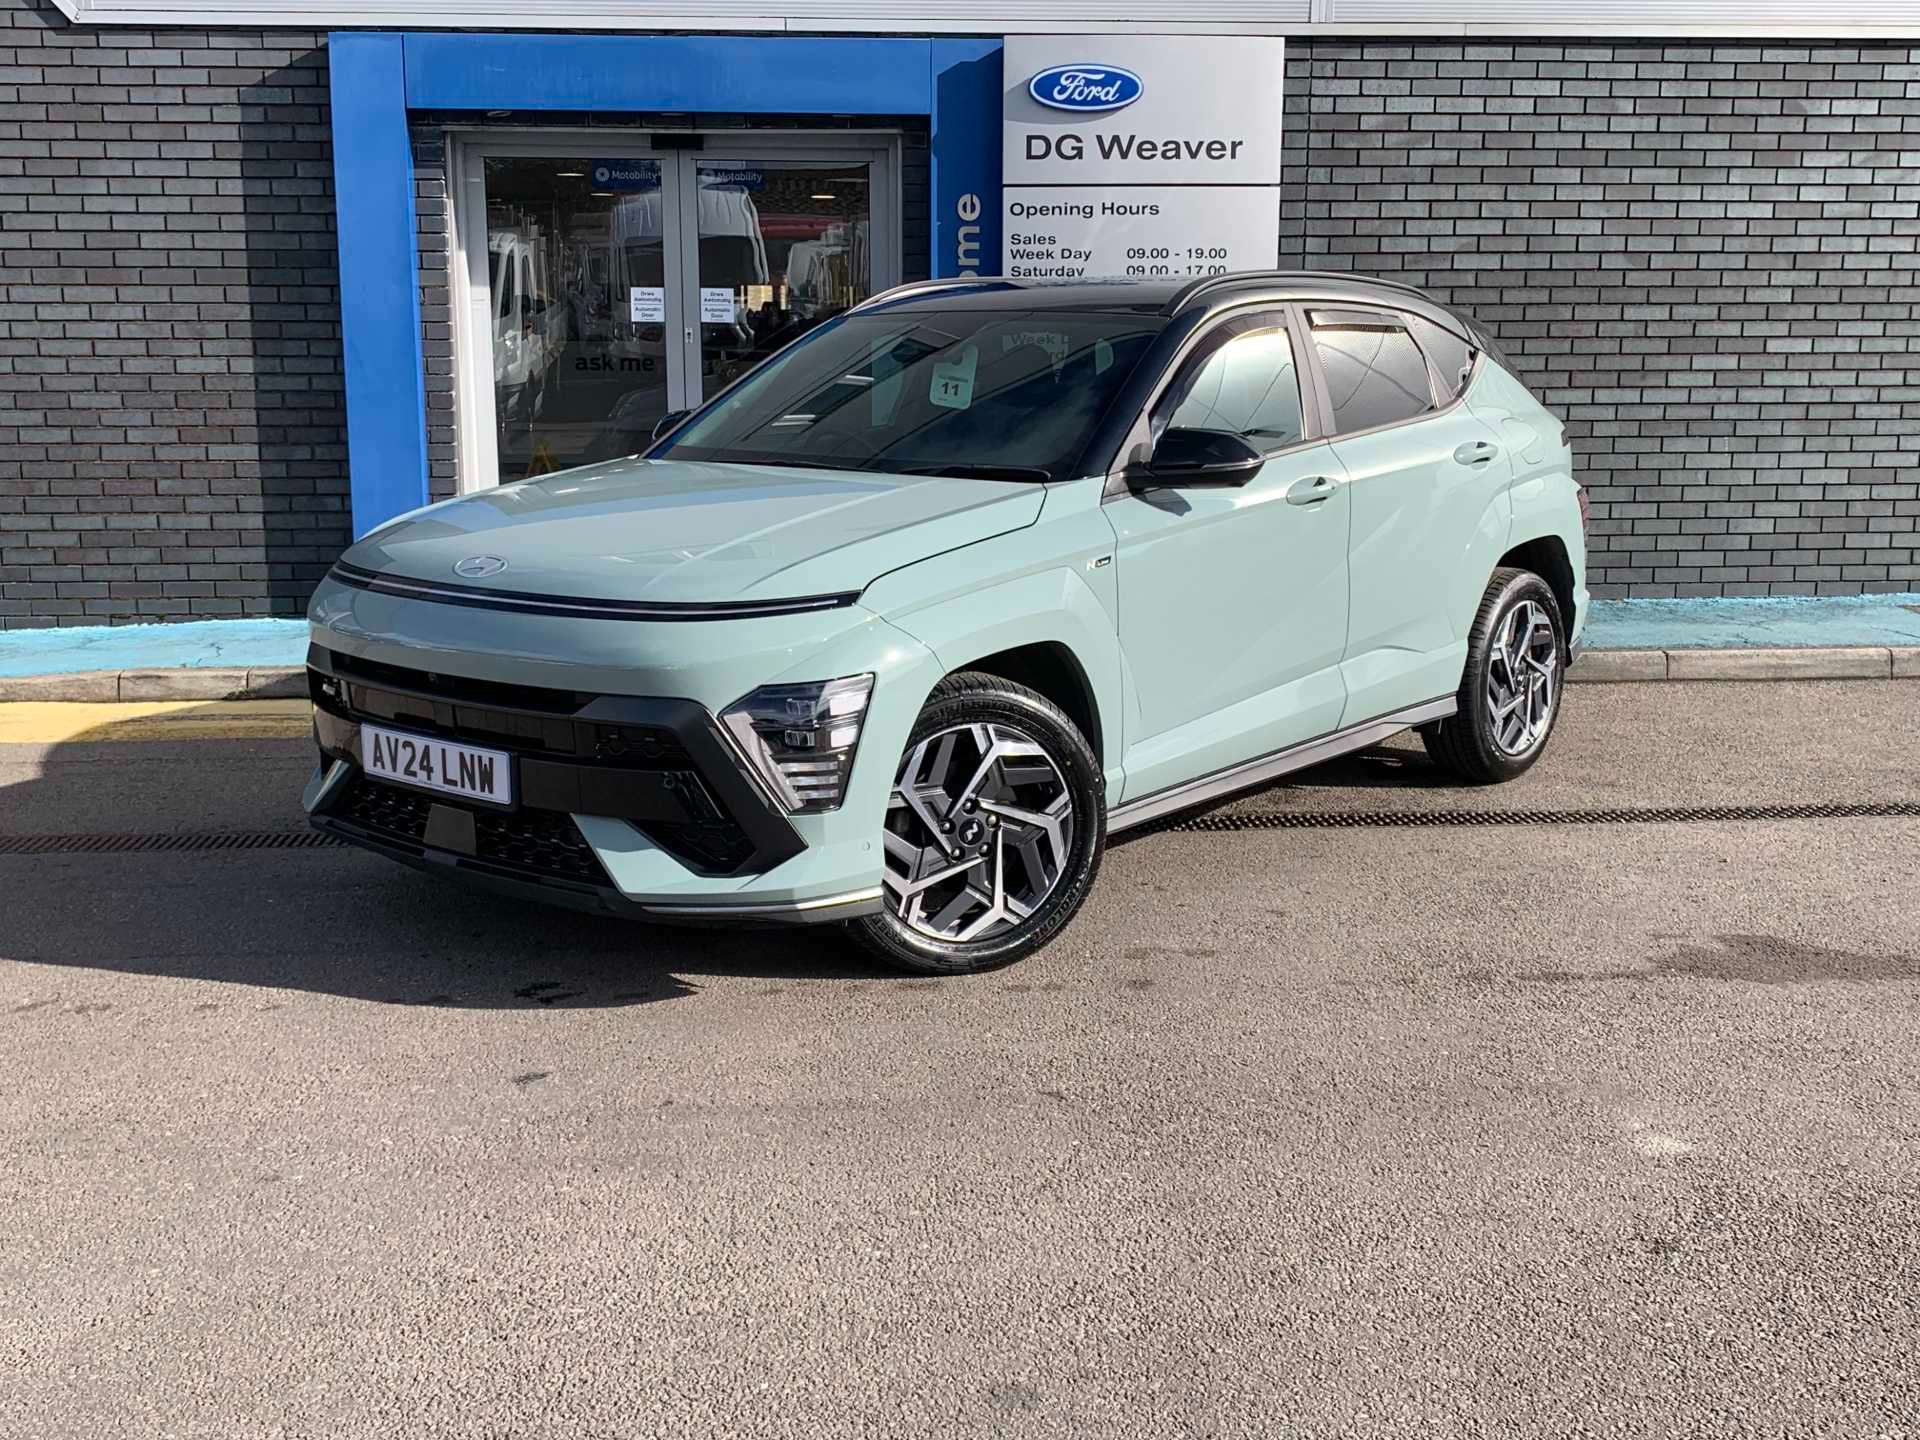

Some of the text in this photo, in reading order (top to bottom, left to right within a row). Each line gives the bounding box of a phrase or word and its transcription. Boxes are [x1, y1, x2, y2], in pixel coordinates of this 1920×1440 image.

[1053, 71, 1122, 101] Ford
[1025, 134, 1244, 161] DG Weaver
[612, 170, 657, 181] Motability
[718, 171, 763, 184] Motability
[1009, 202, 1160, 219] Opening Hours
[1010, 233, 1057, 245] Sales
[1010, 248, 1055, 260] Week
[1061, 248, 1092, 262] Day
[1126, 248, 1169, 259] 09.00
[1186, 248, 1227, 259] 19.00
[1010, 265, 1085, 277] Saturday
[1126, 265, 1169, 276] 0900
[1186, 265, 1226, 276] 1700
[576, 353, 655, 371] ask me
[941, 382, 960, 397] 11
[373, 733, 494, 795] AV24 LNW
